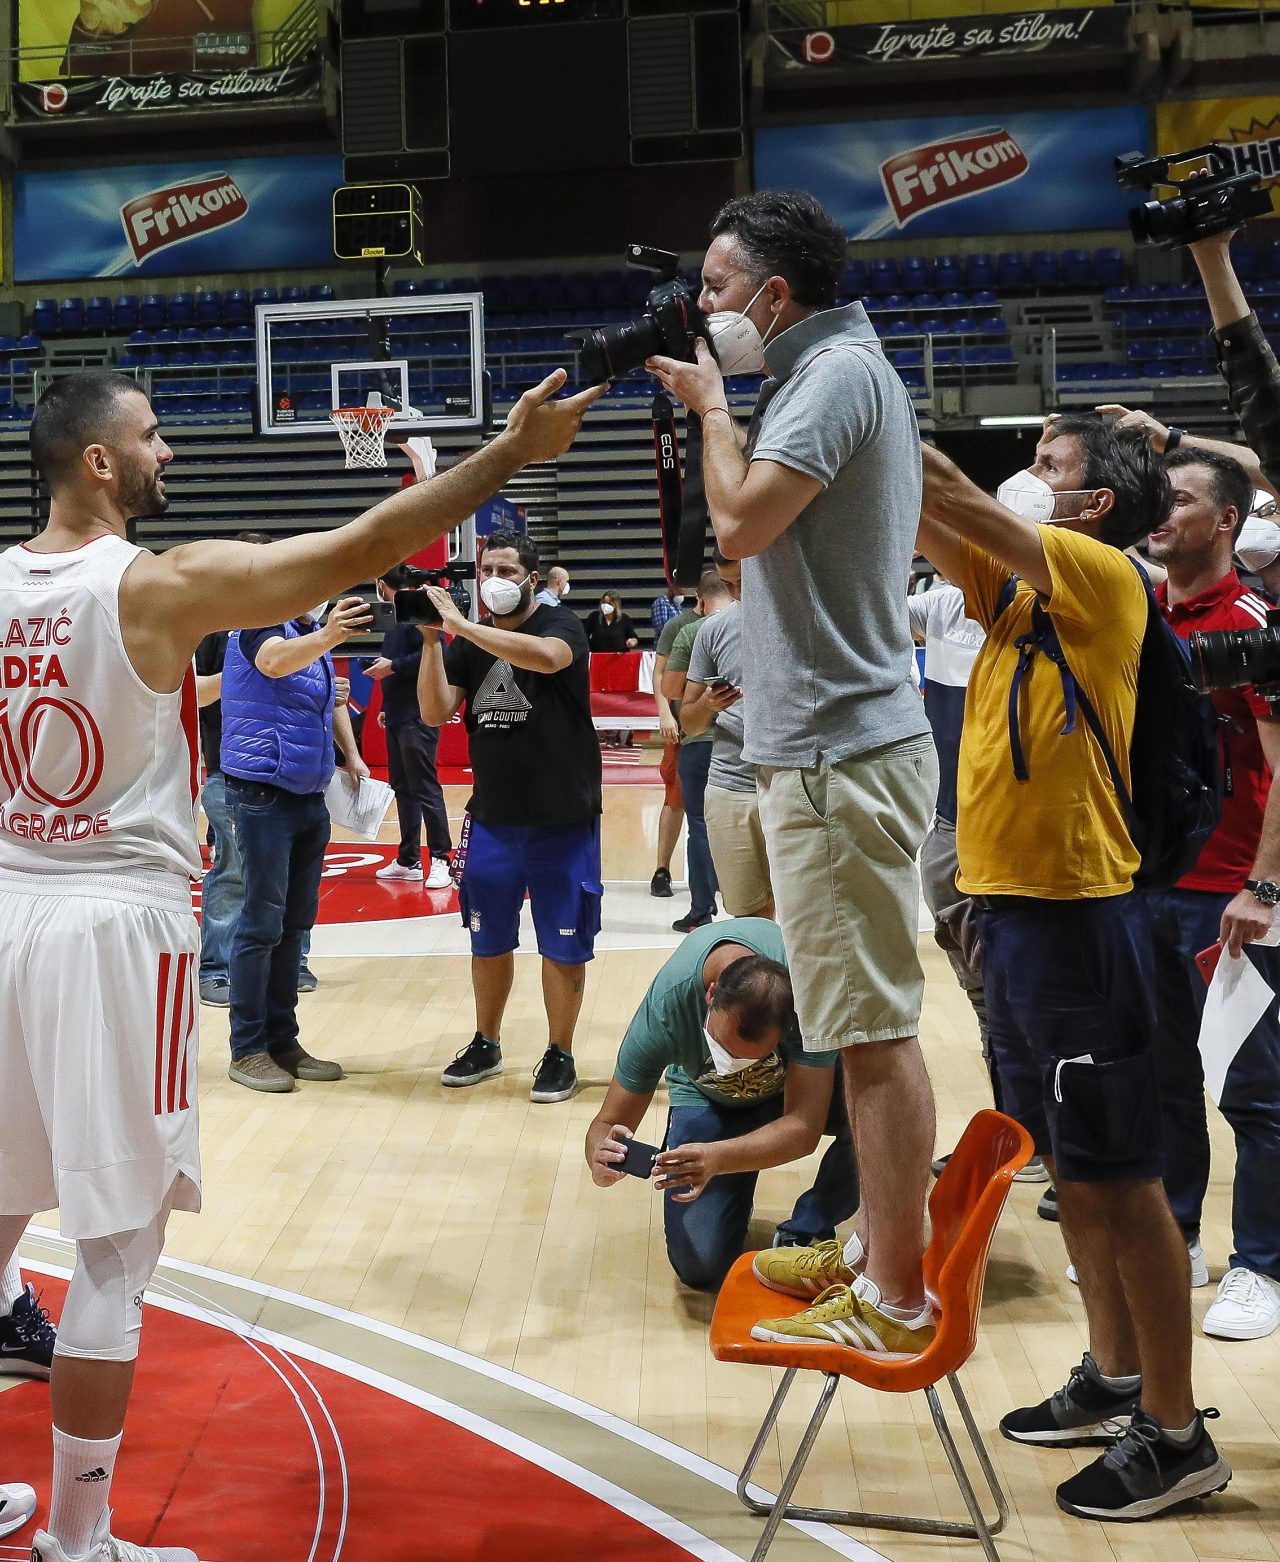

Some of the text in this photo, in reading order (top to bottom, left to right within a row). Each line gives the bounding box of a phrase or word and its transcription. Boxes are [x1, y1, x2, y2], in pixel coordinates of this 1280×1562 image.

[867, 10, 1094, 61] Igrajte sa stilom!
[96, 66, 290, 110] Igrajte sa stilom!
[892, 138, 1021, 208] Frikom
[131, 183, 242, 246] Frikom
[660, 434, 674, 470] EOS
